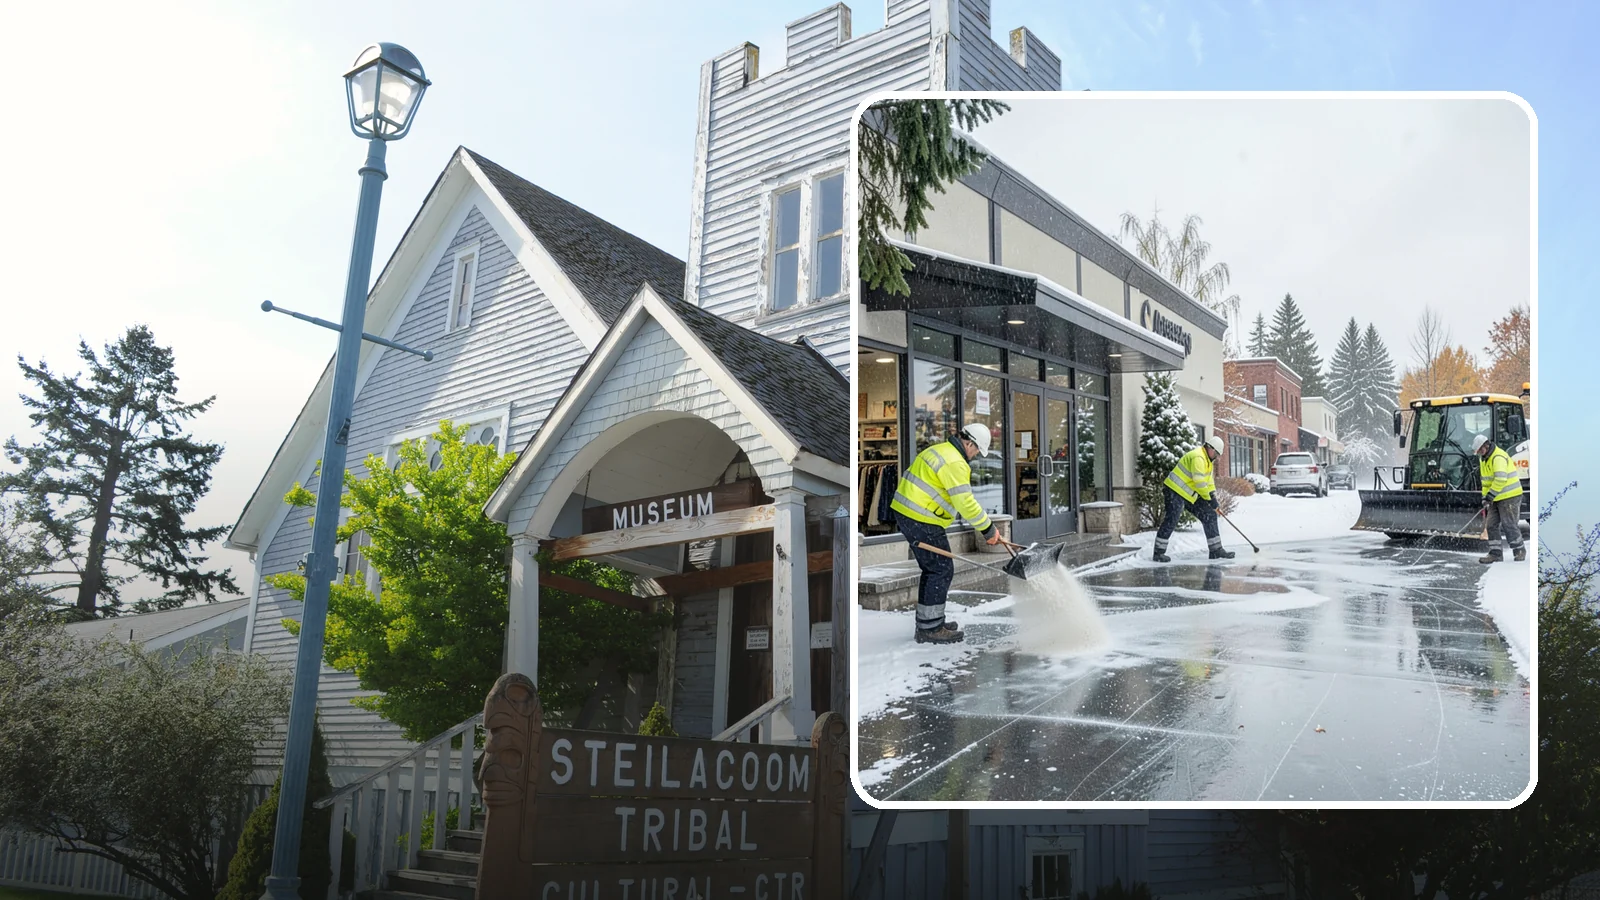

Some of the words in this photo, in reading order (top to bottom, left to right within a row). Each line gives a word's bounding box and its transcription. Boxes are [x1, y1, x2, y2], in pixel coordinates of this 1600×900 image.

[613, 491, 713, 530] MUSEUM
[550, 738, 810, 792] STEILACOOM
[615, 806, 758, 851] TRIBAL
